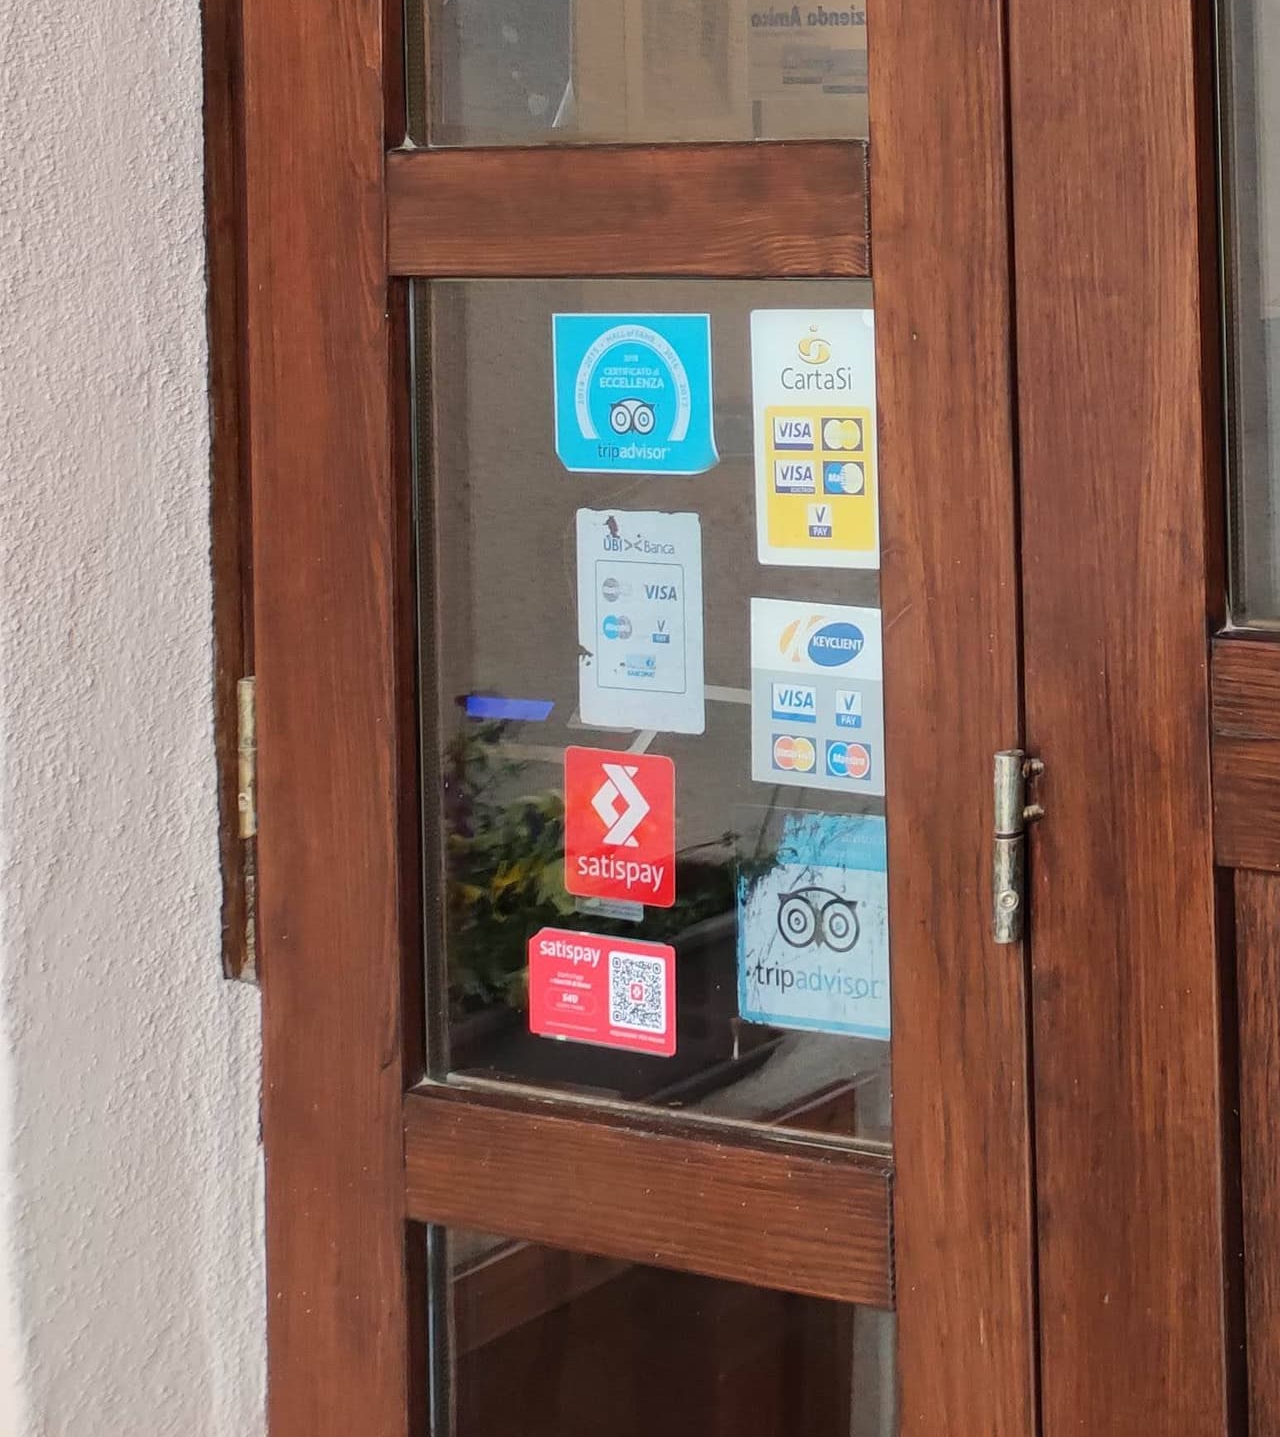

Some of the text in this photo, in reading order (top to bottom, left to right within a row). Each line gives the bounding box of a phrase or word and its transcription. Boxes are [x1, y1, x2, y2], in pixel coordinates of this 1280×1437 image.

[600, 377, 664, 389] ECCELLENZA
[781, 367, 852, 390] CartaSi
[779, 421, 812, 439] VISA
[598, 443, 667, 462] tripadvisor
[781, 465, 814, 482] VISA
[644, 540, 675, 555] Banca
[645, 584, 678, 601] VISA
[812, 635, 863, 651] KEYCLIENT
[778, 689, 814, 709] VISA
[577, 855, 664, 892] satispay
[539, 939, 601, 968] satispay
[755, 961, 880, 999] tripadvisor
